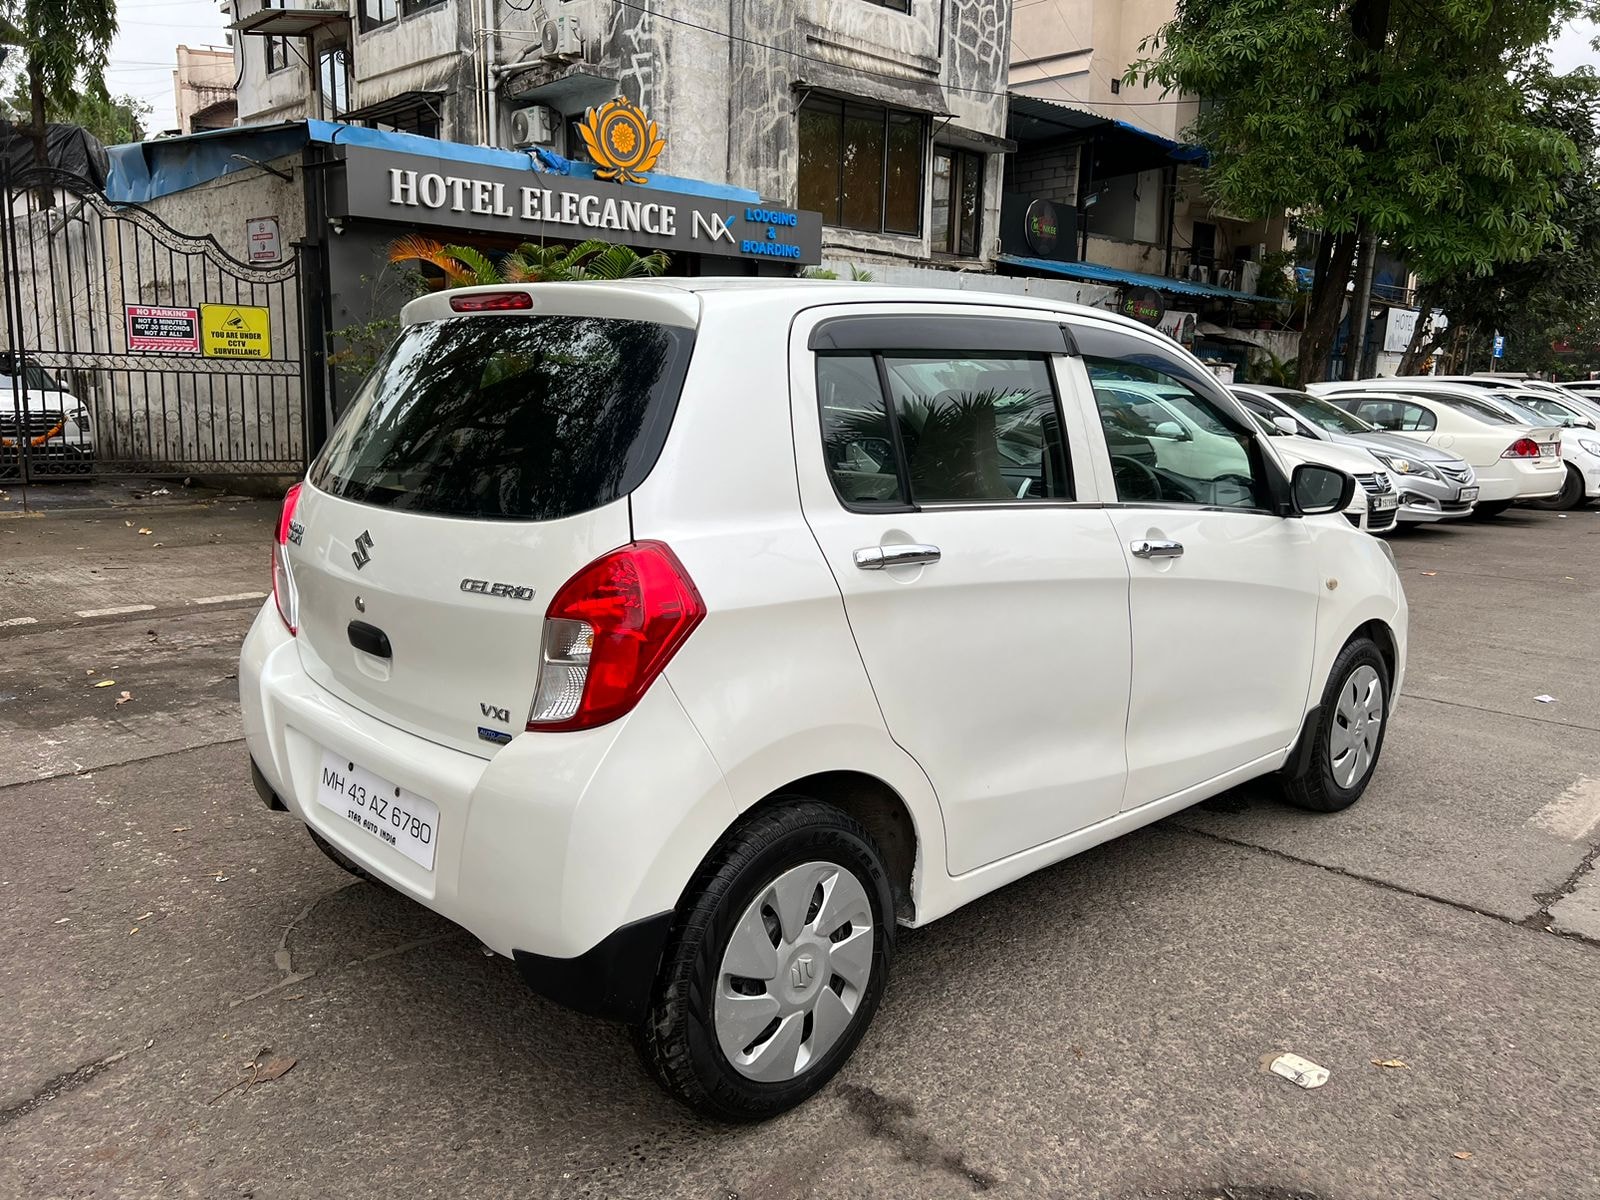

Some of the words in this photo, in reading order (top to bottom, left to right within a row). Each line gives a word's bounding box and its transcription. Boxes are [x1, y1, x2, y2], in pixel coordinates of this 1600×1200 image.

[388, 168, 513, 217] HOTEL
[520, 185, 677, 236] ELEGANCE
[744, 207, 797, 227] LODGING
[767, 226, 777, 240] &
[741, 239, 800, 258] BOARDING
[136, 308, 149, 316] NO
[151, 309, 188, 317] PARKING
[211, 331, 225, 339] YOU
[239, 332, 262, 340] UNDER
[213, 348, 261, 356] SURVEILLANCE
[227, 340, 246, 348] CCTV
[480, 702, 511, 723] VXI
[479, 729, 496, 738] AUTO
[322, 767, 345, 795] MH
[347, 783, 366, 807] 43
[368, 795, 389, 820] AZ
[391, 806, 432, 845] 6780
[347, 809, 362, 826] STAR
[362, 818, 379, 835] AUTO
[379, 828, 397, 846] INDIA
